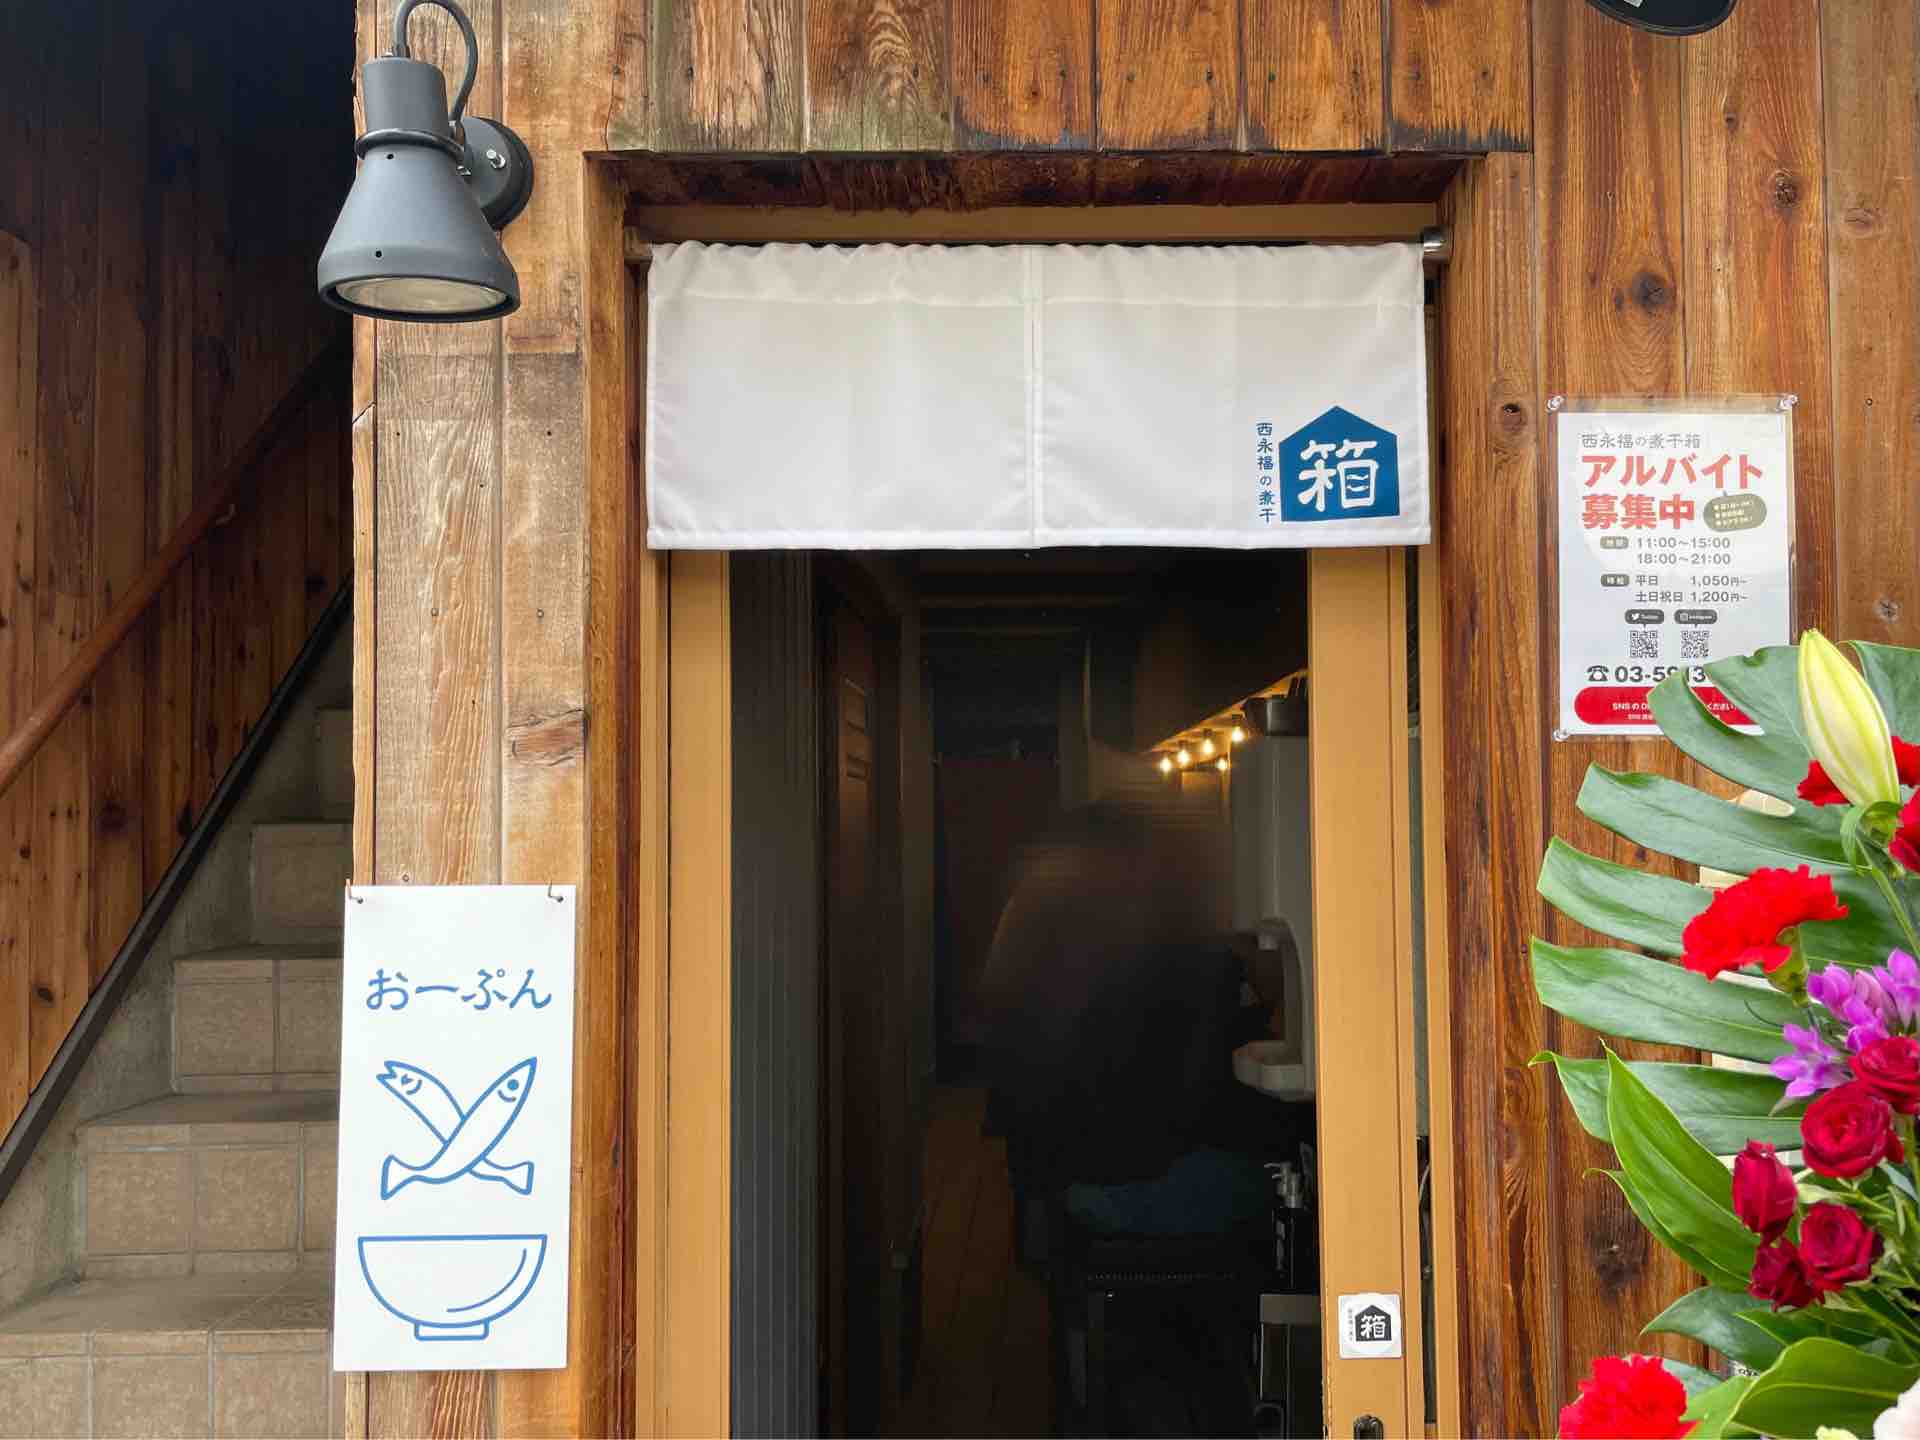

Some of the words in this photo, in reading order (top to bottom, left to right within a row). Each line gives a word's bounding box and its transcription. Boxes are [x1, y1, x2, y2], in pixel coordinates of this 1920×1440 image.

[1581, 432, 1701, 449] 西永福の煮干箱
[1255, 422, 1276, 524] 西永福の煮干
[1298, 439, 1379, 512] 箱
[1581, 452, 1763, 490] アルバイト
[1581, 493, 1696, 530] 募集中
[1635, 575, 1659, 587] 平日
[1635, 591, 1684, 603] 土日祝日
[365, 968, 552, 1011] おーぷん
[1360, 1314, 1386, 1339] 箱
